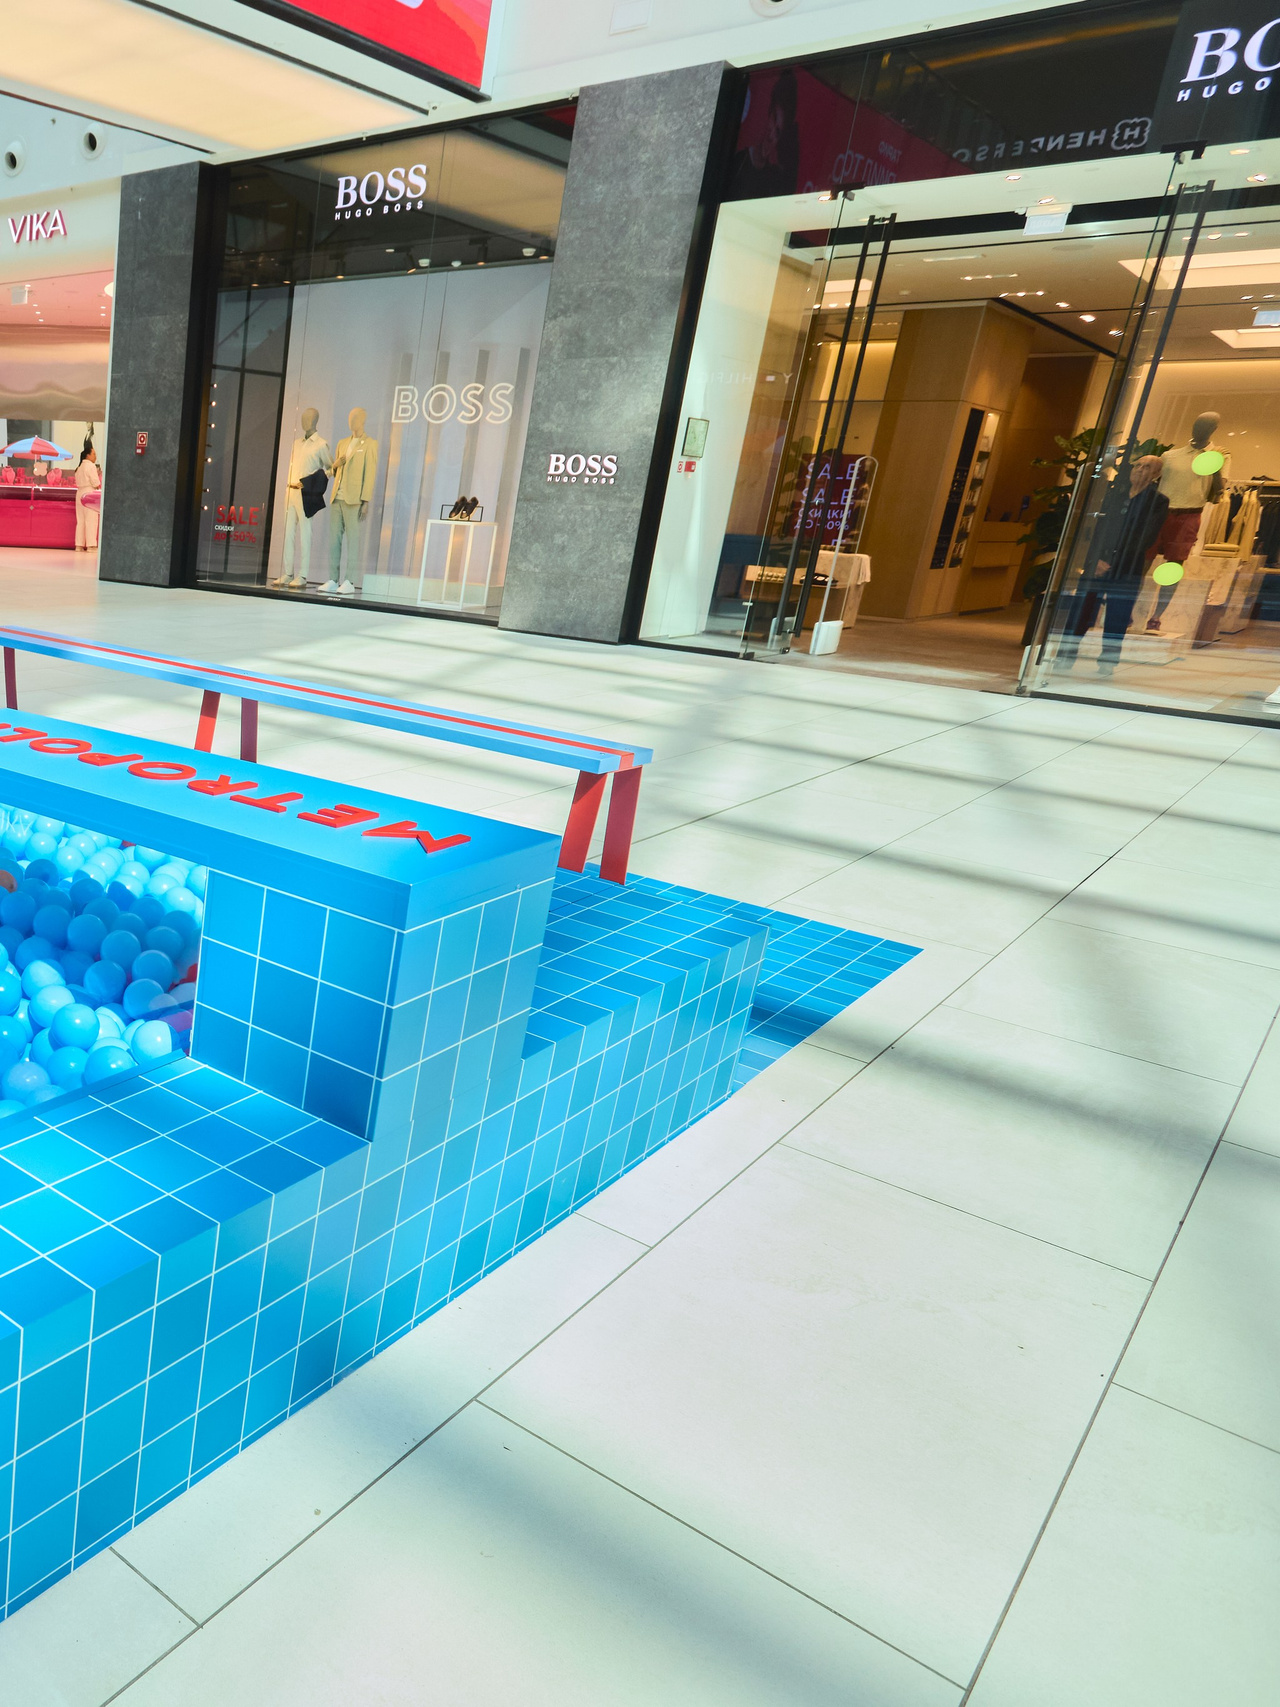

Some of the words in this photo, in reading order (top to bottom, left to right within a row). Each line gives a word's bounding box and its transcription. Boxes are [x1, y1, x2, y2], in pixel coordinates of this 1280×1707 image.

[1177, 76, 1272, 102] HUGO
[335, 164, 427, 209] BOSS
[334, 208, 372, 220] HUGO
[383, 200, 423, 214] BOSS
[8, 209, 67, 244] VIKA
[391, 382, 515, 424] BOSS
[547, 453, 618, 476] BOSS
[547, 475, 577, 483] HUGO
[583, 477, 615, 485] BOSS
[216, 505, 259, 525] SALE
